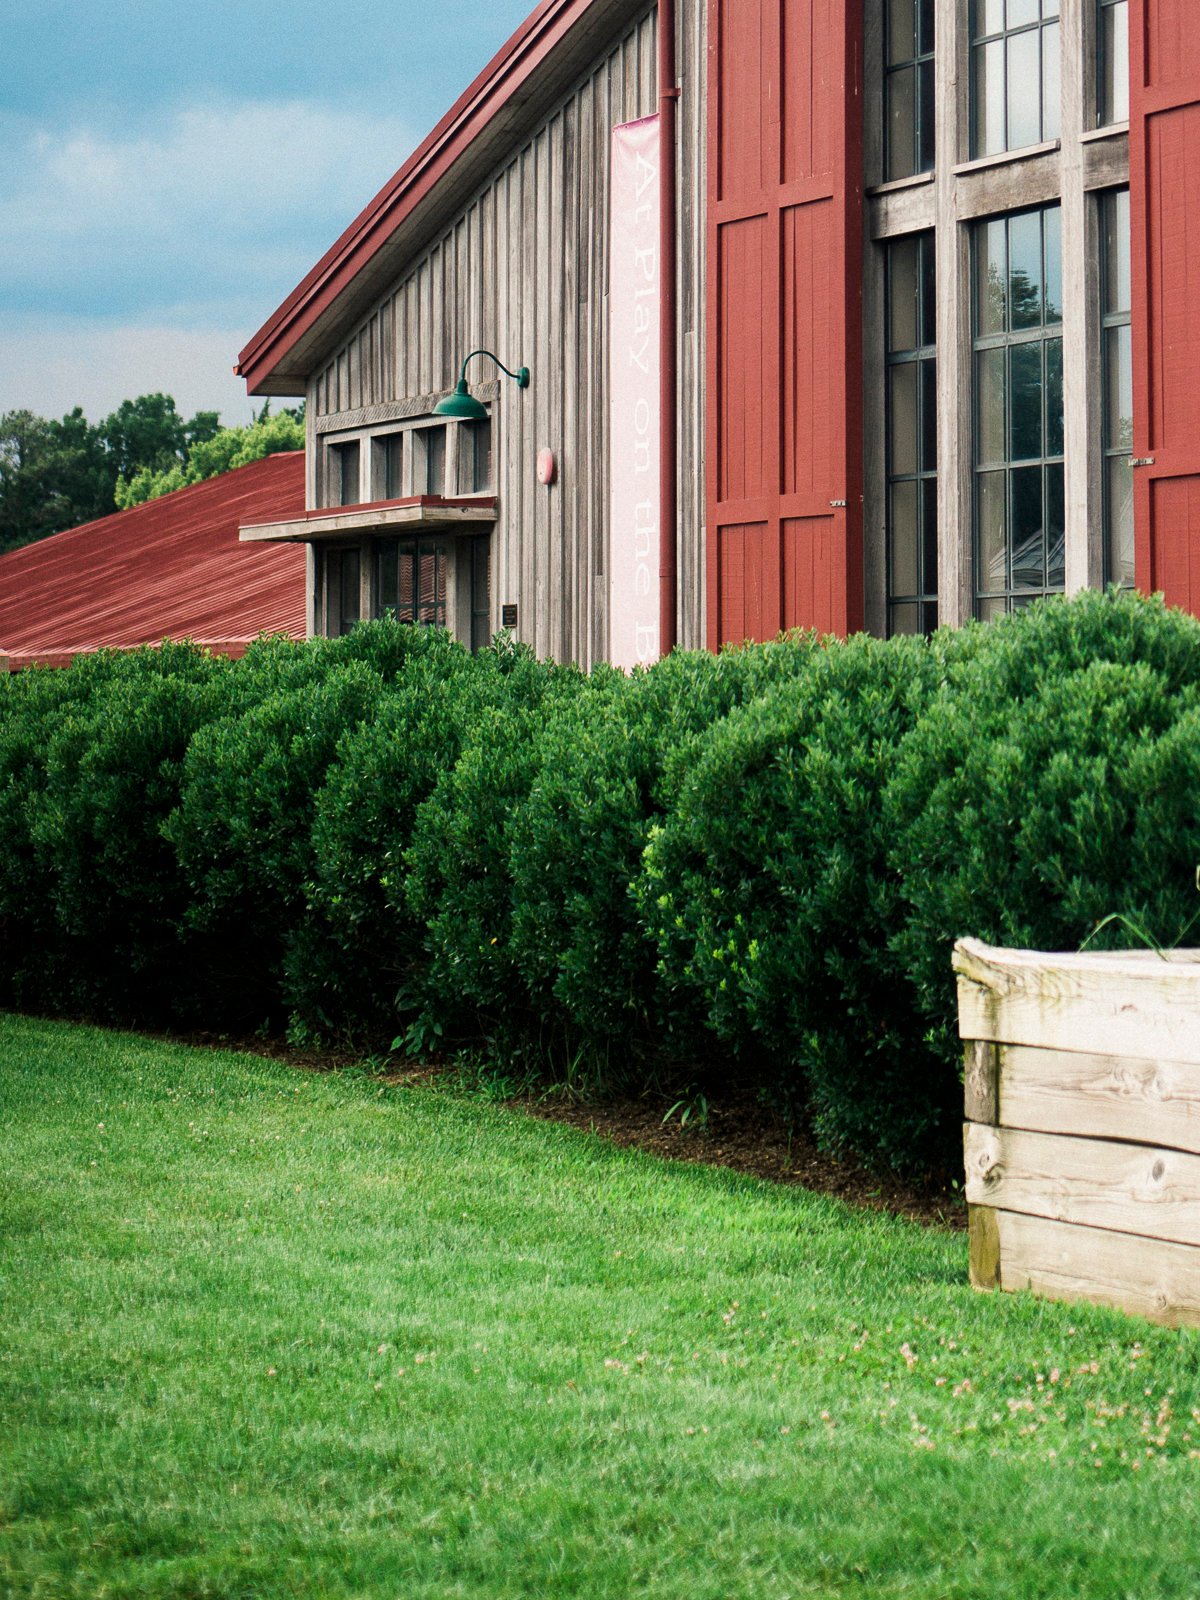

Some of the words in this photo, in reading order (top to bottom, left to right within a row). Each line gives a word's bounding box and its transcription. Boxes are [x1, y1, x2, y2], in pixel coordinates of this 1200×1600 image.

[635, 151, 657, 224] At
[629, 243, 657, 374] Play
[634, 398, 650, 476] on
[635, 498, 657, 597] the
